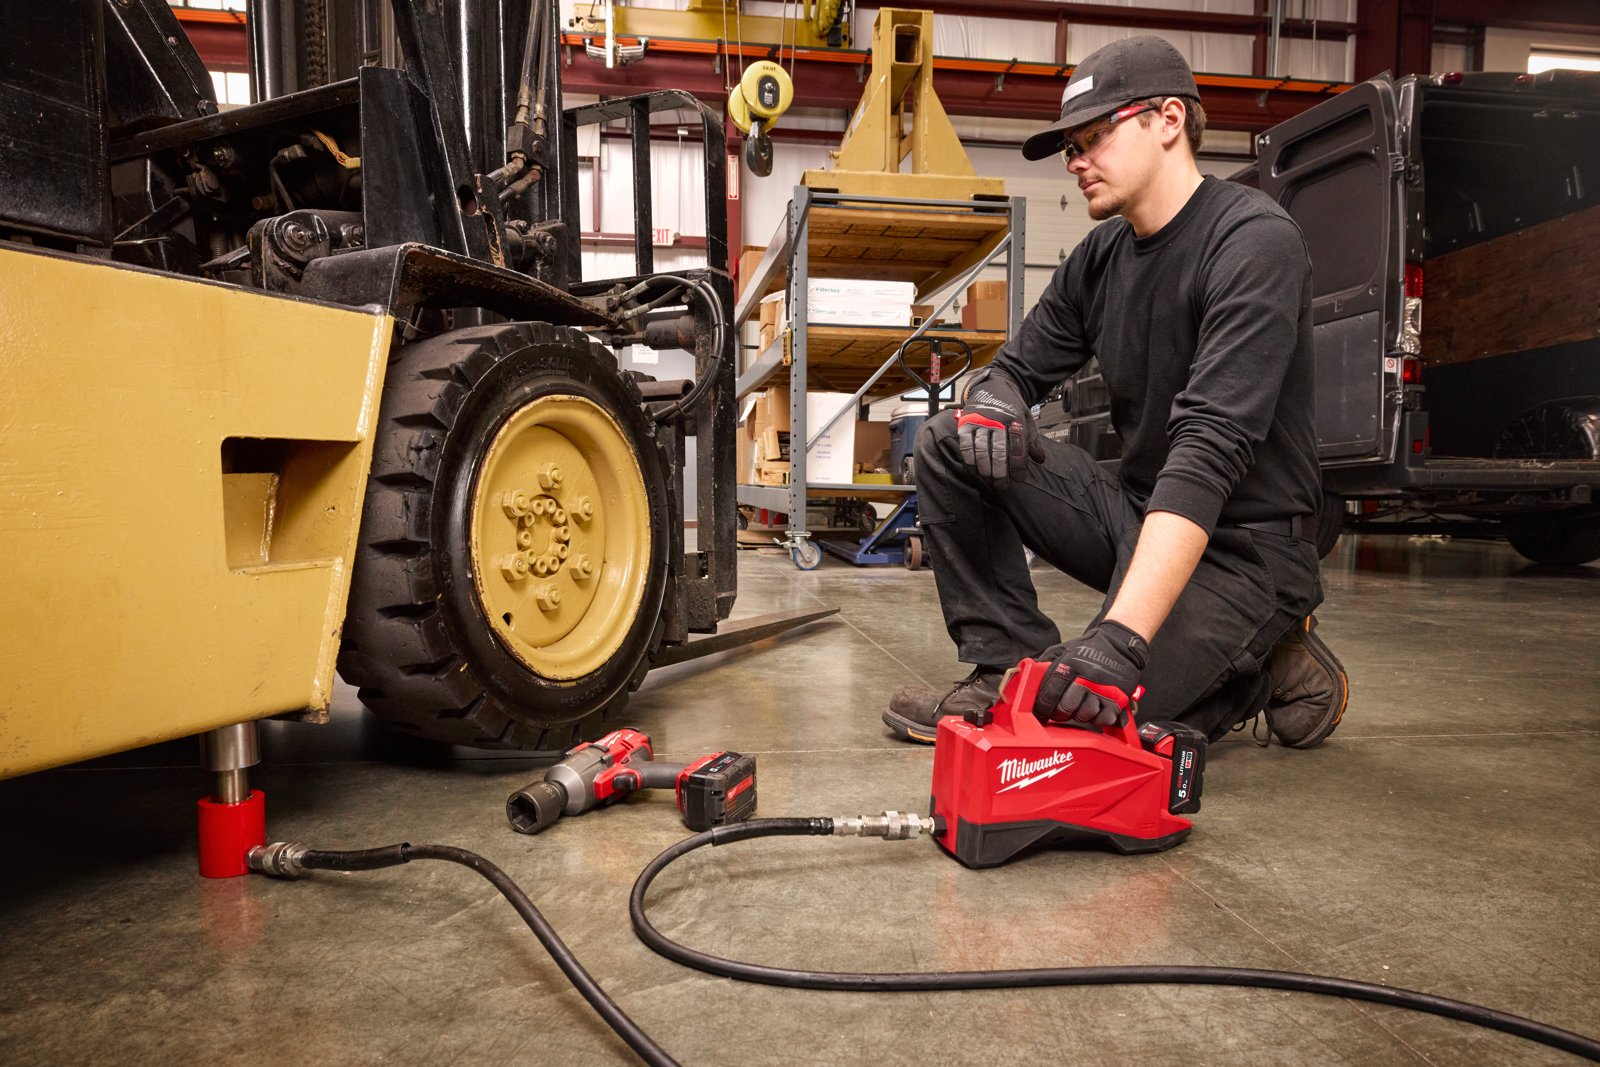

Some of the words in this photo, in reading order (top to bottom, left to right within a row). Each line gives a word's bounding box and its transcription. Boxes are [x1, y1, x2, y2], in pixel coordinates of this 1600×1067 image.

[652, 228, 670, 243] EXIT
[1076, 645, 1133, 676] Milwauk
[996, 750, 1074, 784] Milwaukee
